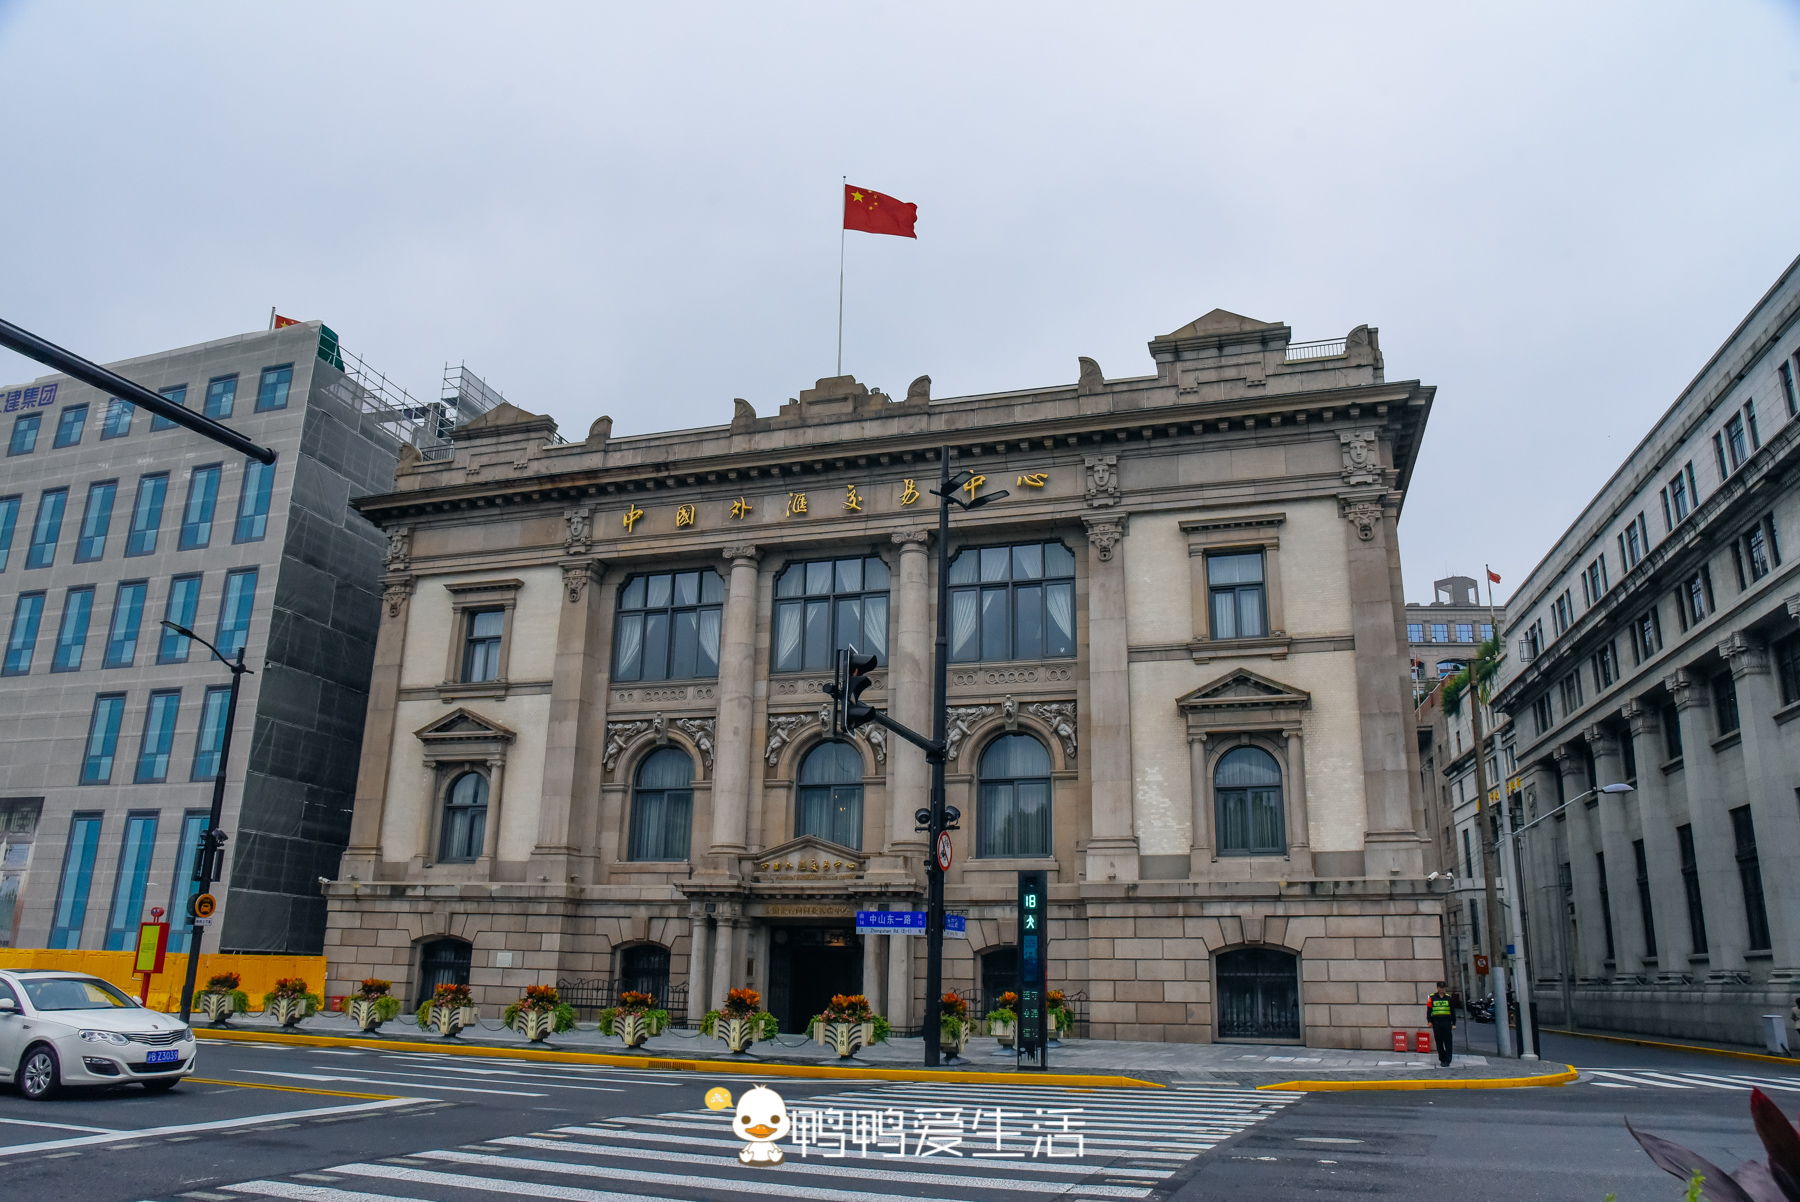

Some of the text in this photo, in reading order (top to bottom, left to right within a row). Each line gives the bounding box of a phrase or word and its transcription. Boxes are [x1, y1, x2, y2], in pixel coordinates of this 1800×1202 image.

[0, 383, 58, 413] 建集团
[1025, 894, 1036, 908] 18
[869, 914, 912, 925] 中山东一路
